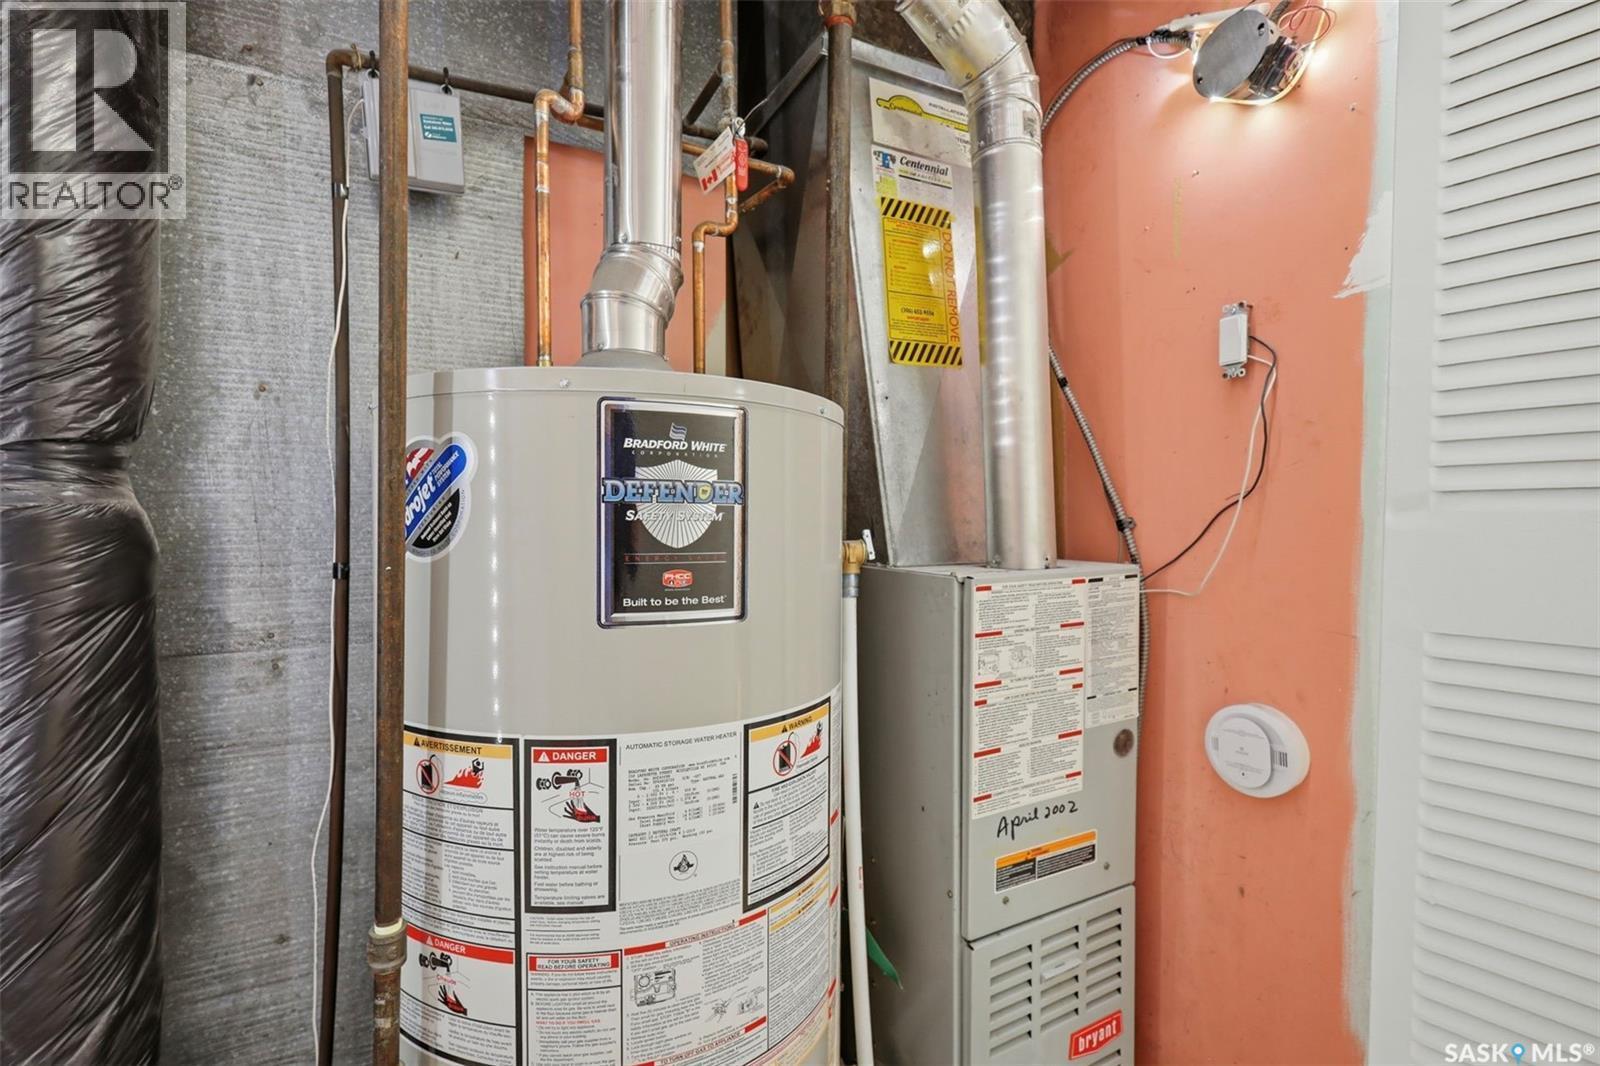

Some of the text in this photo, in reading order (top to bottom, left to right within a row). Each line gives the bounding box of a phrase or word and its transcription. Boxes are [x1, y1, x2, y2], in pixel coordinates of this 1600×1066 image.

[900, 156, 949, 176] Centennial
[942, 231, 960, 342] DO NOT REMOVE
[623, 438, 725, 452] BRADFORD WHITE
[632, 450, 718, 458] CORPORATION
[603, 480, 743, 504] DEFENDER
[625, 511, 674, 521] SAFETY
[623, 598, 647, 607] Built
[650, 598, 662, 606] to
[665, 597, 678, 605] be
[682, 596, 698, 605] the
[625, 731, 737, 750] AUTOMATIC STORAGE WATER HEATER
[421, 742, 482, 754] AVERTISSEMENT
[552, 752, 596, 760] DANGER
[997, 800, 1078, 840] April 2002
[434, 939, 465, 953] DANGER
[1078, 1019, 1116, 1052] bryant
